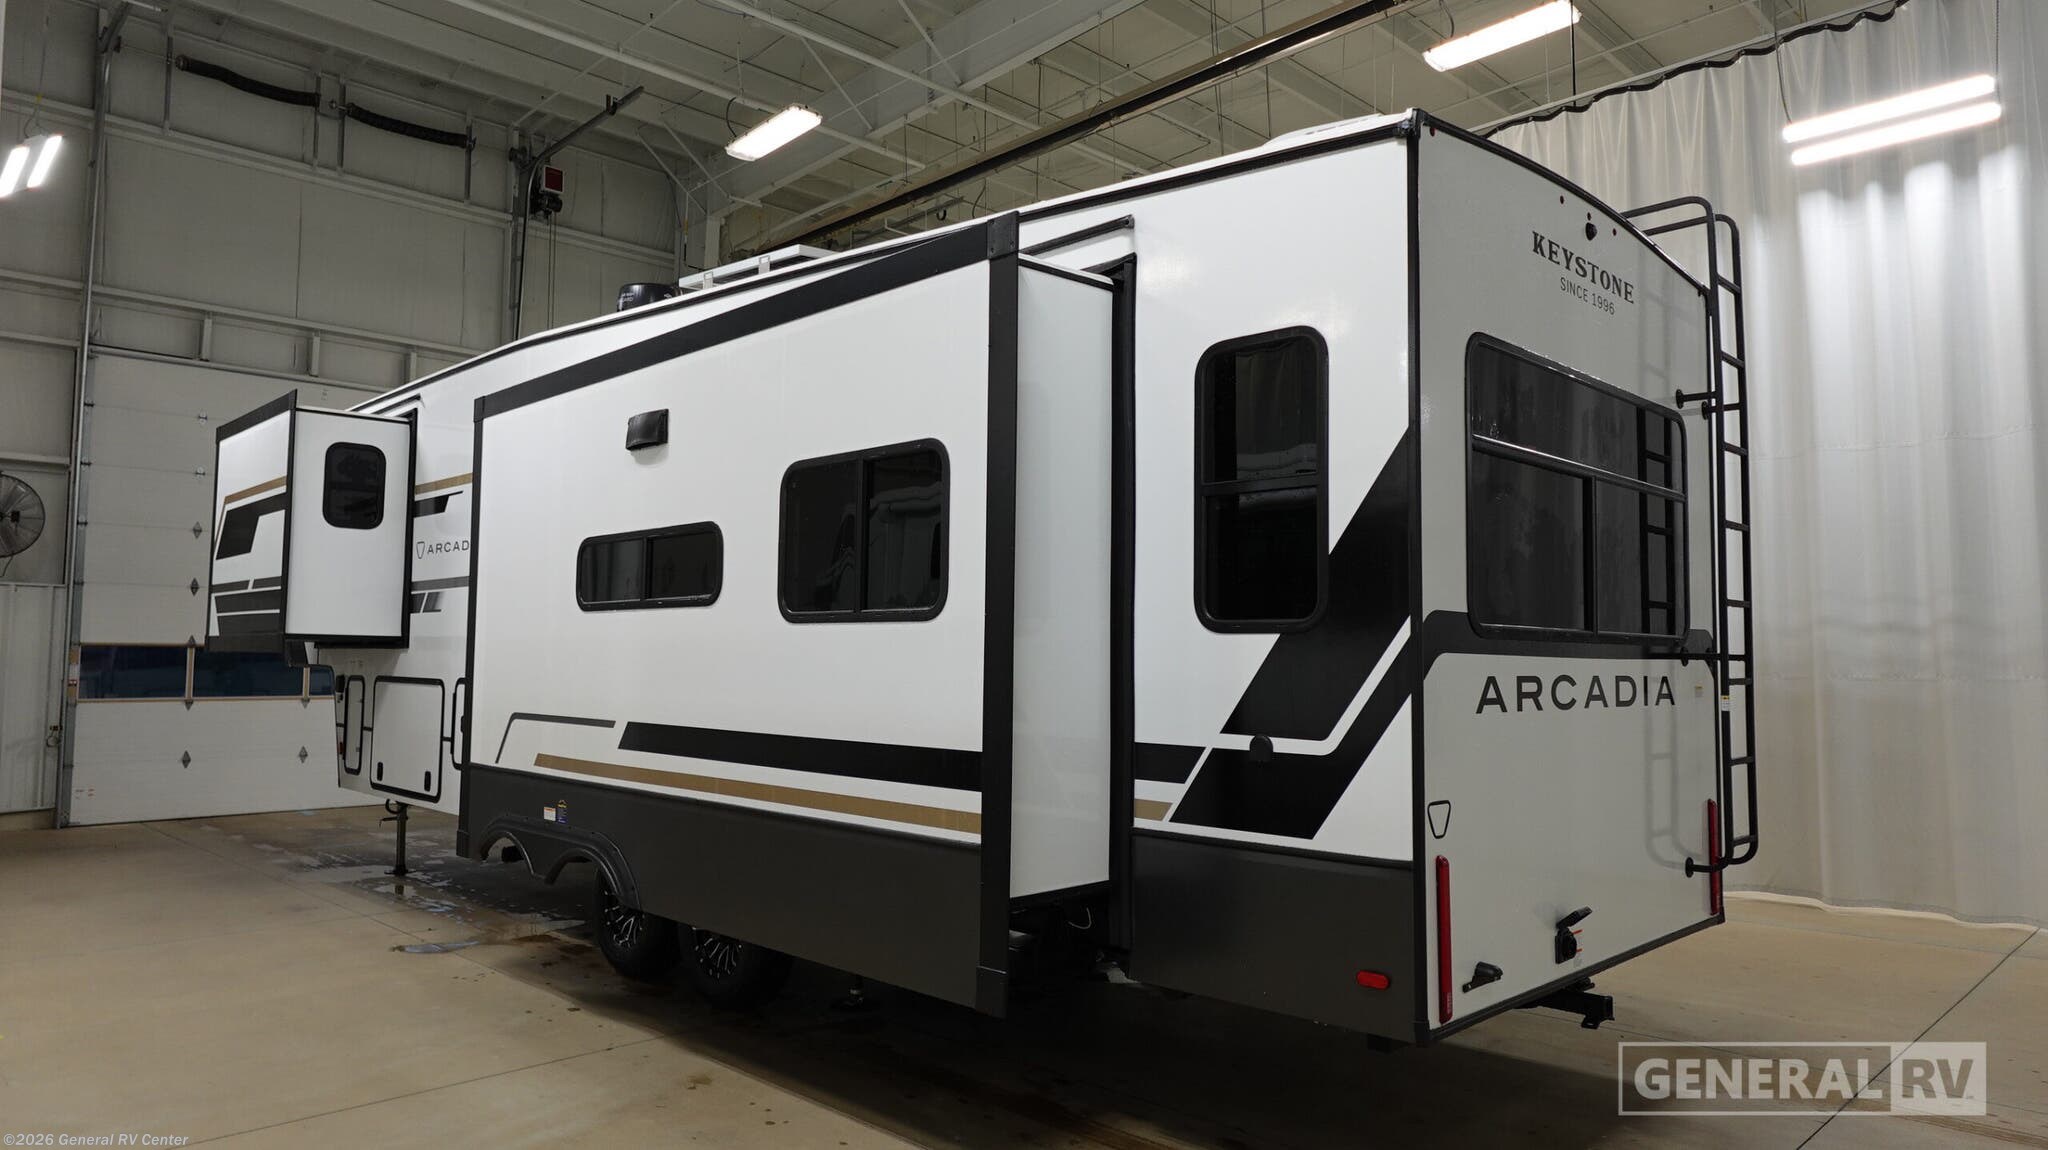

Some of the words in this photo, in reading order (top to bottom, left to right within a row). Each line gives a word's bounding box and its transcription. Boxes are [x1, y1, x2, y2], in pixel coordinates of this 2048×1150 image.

[1532, 231, 1634, 304] KEYSTONE
[1560, 277, 1588, 303] SINCE
[1592, 294, 1615, 315] 1996
[1475, 674, 1676, 714] ARCADIA
